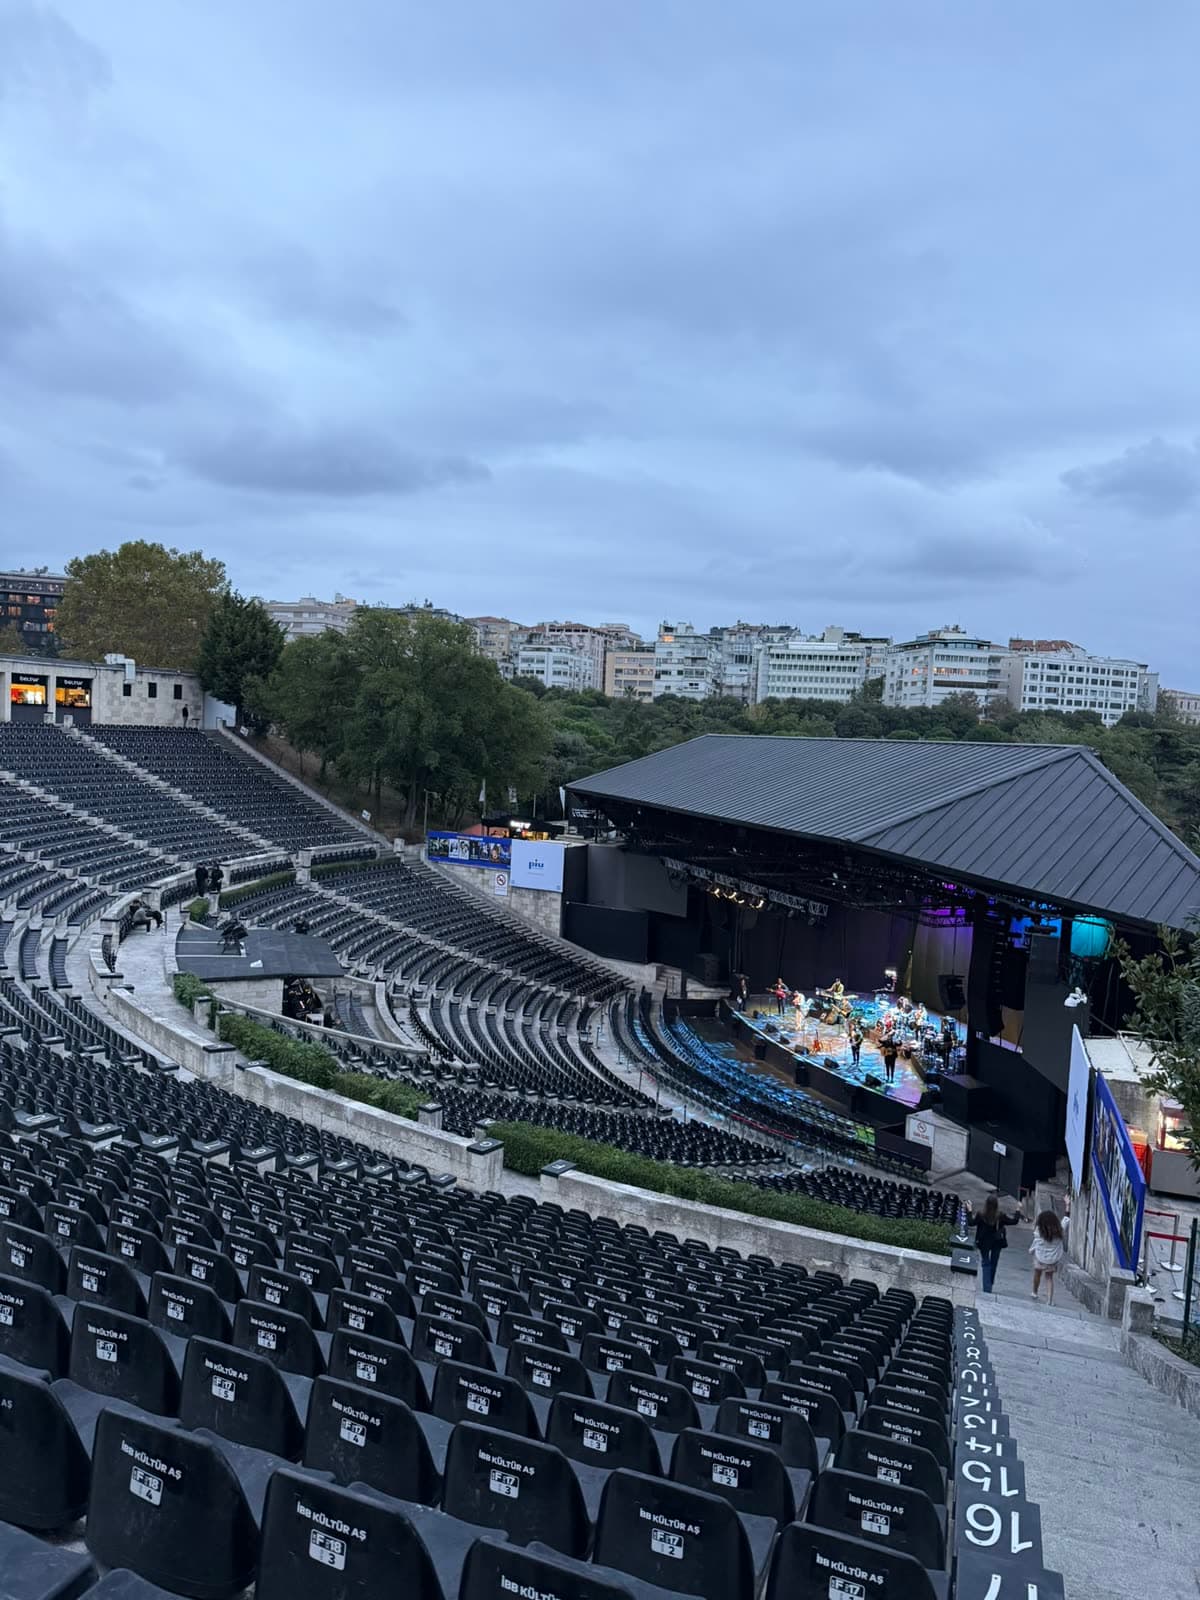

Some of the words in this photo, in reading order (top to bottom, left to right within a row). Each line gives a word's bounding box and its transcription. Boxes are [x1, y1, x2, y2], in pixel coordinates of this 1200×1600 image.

[121, 1440, 134, 1456] İBB
[134, 1450, 167, 1474] KÜLTÜR
[168, 1466, 182, 1480] AŞ
[492, 1456, 522, 1472] KÜLTÜR
[712, 1452, 740, 1464] KÜLTÜR
[136, 1470, 144, 1480] F
[148, 1477, 159, 1490] 18
[962, 1460, 1018, 1497] 15
[146, 1490, 152, 1500] 4
[505, 1486, 512, 1494] 3
[862, 1498, 892, 1512] KÜLTÜR
[296, 1500, 312, 1518] İBB
[312, 1512, 350, 1536] KÜLTÜR
[350, 1528, 367, 1542] AŞ
[652, 1514, 686, 1532] KÜLTÜR
[965, 1503, 1032, 1554] 16
[316, 1533, 325, 1545] F
[330, 1540, 342, 1554] 18
[668, 1546, 676, 1556] 2
[328, 1553, 336, 1564] 3
[830, 1560, 868, 1580] KÜLTÜR
[868, 1574, 884, 1585] AŞ
[501, 1574, 518, 1592] İBB
[835, 1580, 844, 1590] F
[850, 1584, 860, 1596] 17
